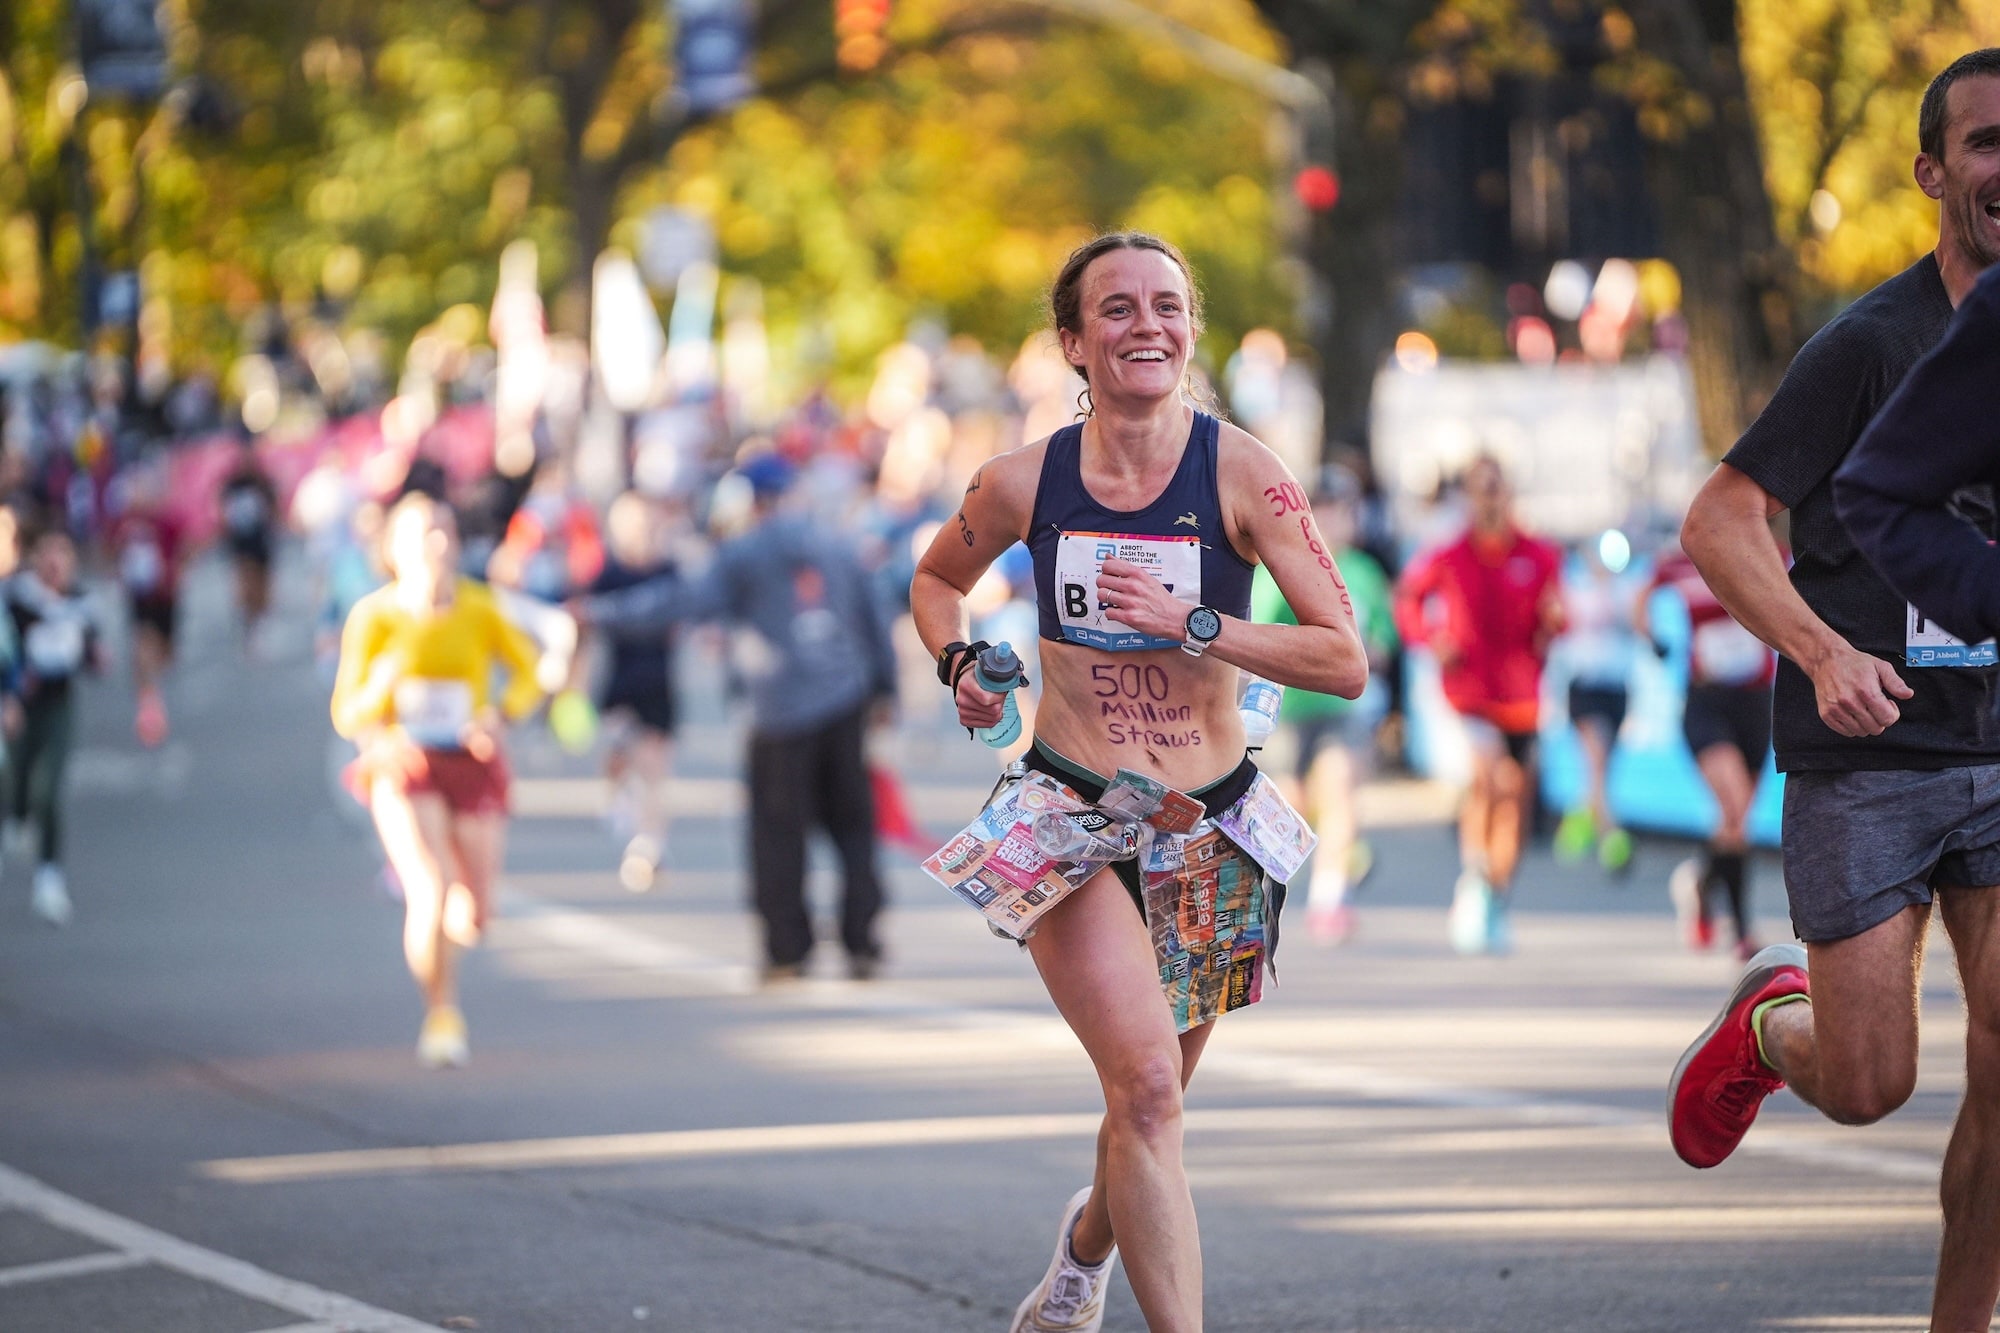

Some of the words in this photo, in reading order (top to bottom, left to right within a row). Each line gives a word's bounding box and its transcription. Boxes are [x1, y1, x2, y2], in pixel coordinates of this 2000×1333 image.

[1088, 634, 1108, 644] Abbott
[1091, 663, 1169, 701] 500
[1101, 701, 1191, 724] Million
[1107, 723, 1201, 748] Straws
[1155, 842, 1184, 853] PURE
[1199, 879, 1214, 926] easy
